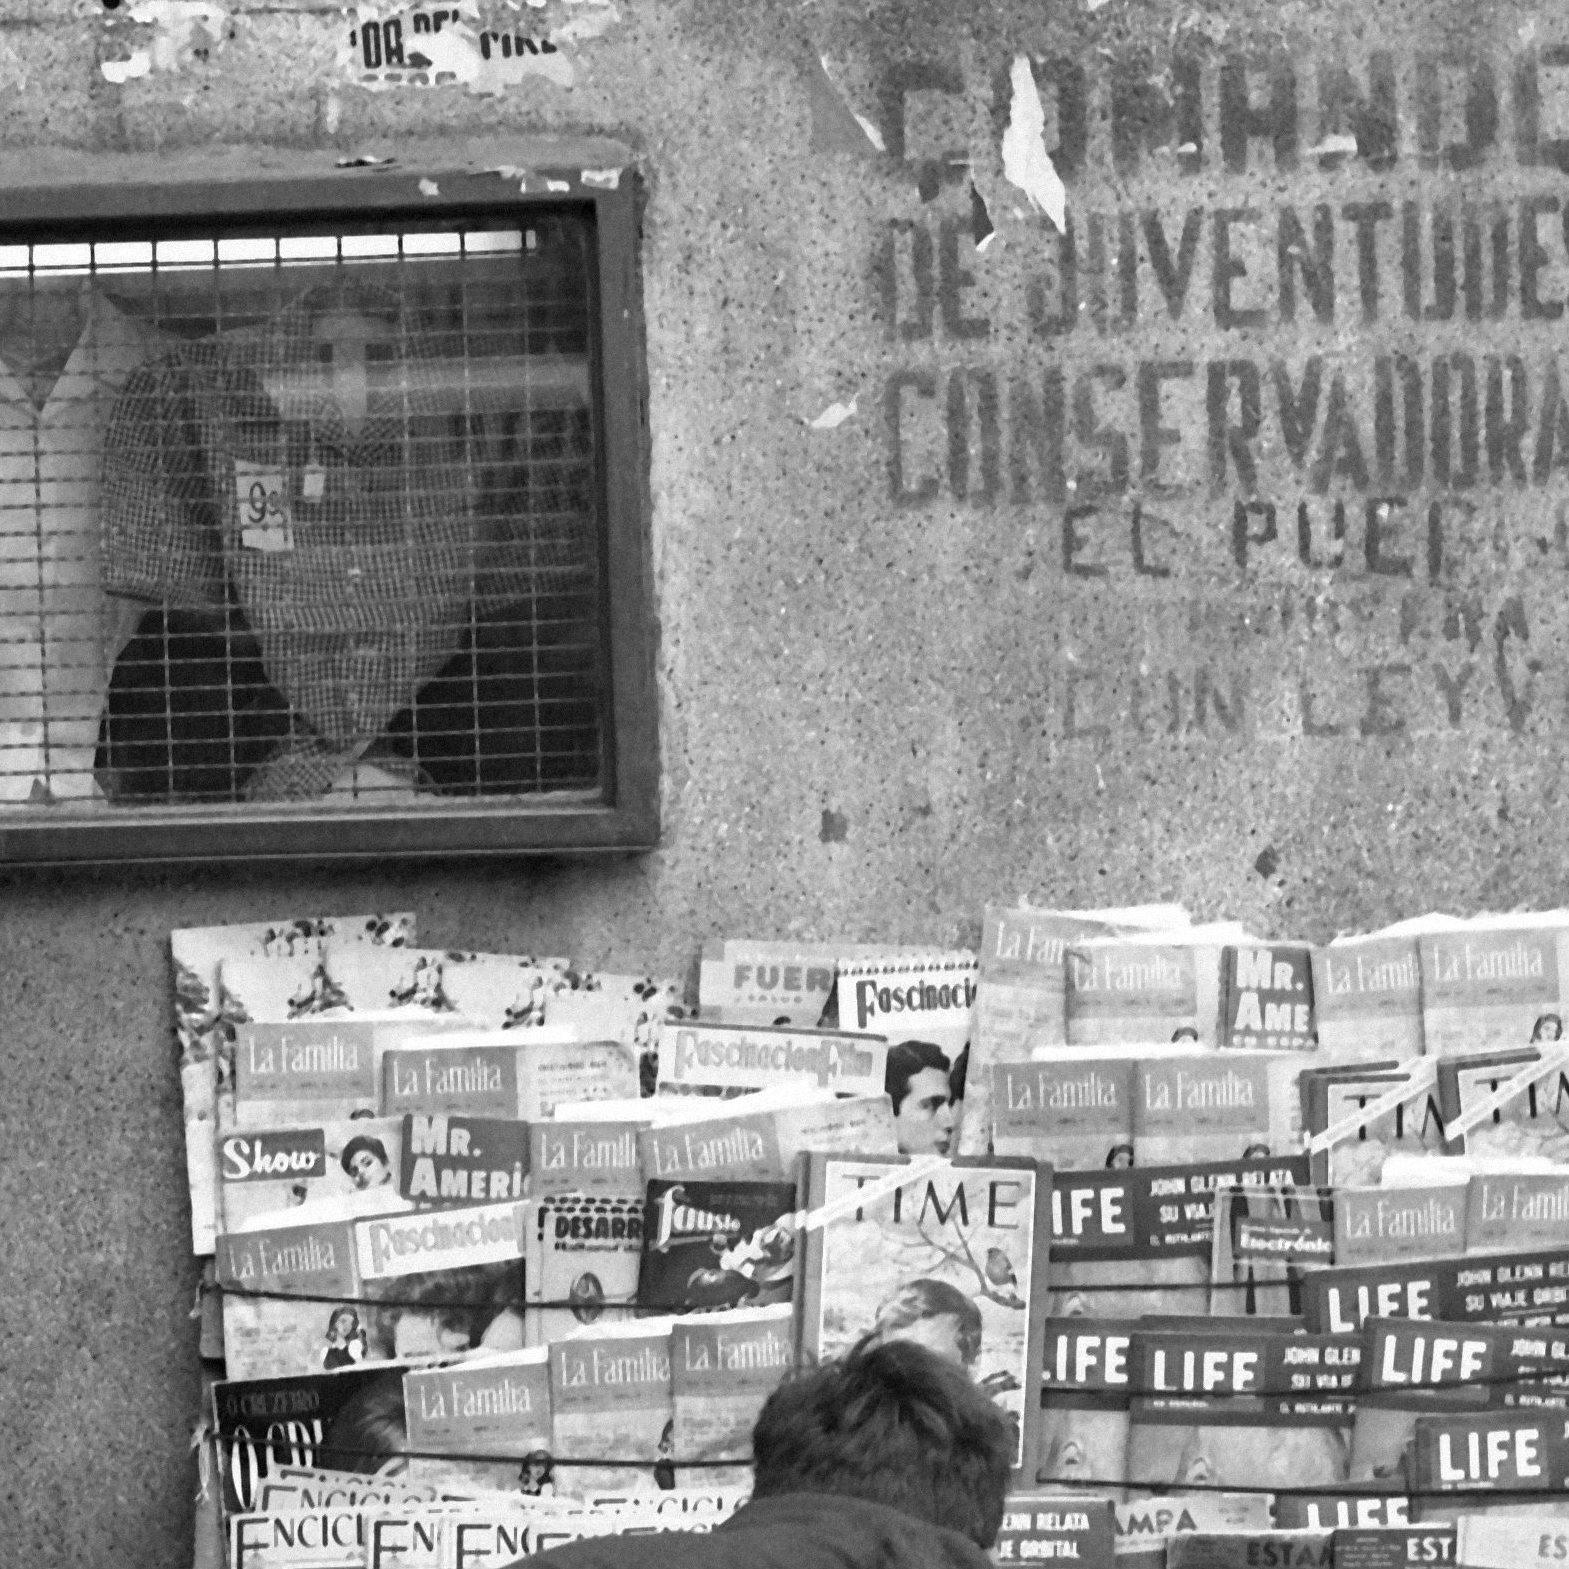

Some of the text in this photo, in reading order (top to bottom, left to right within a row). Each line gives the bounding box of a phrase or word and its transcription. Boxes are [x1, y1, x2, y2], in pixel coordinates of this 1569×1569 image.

[223, 1138, 317, 1179] Show
[840, 1174, 1023, 1230] TIME
[1051, 1186, 1128, 1236] IFE
[1327, 1280, 1433, 1331] LIFE
[1043, 1334, 1129, 1384] IFE
[1153, 1349, 1260, 1392] LIFE
[1438, 1429, 1542, 1481] LIFE
